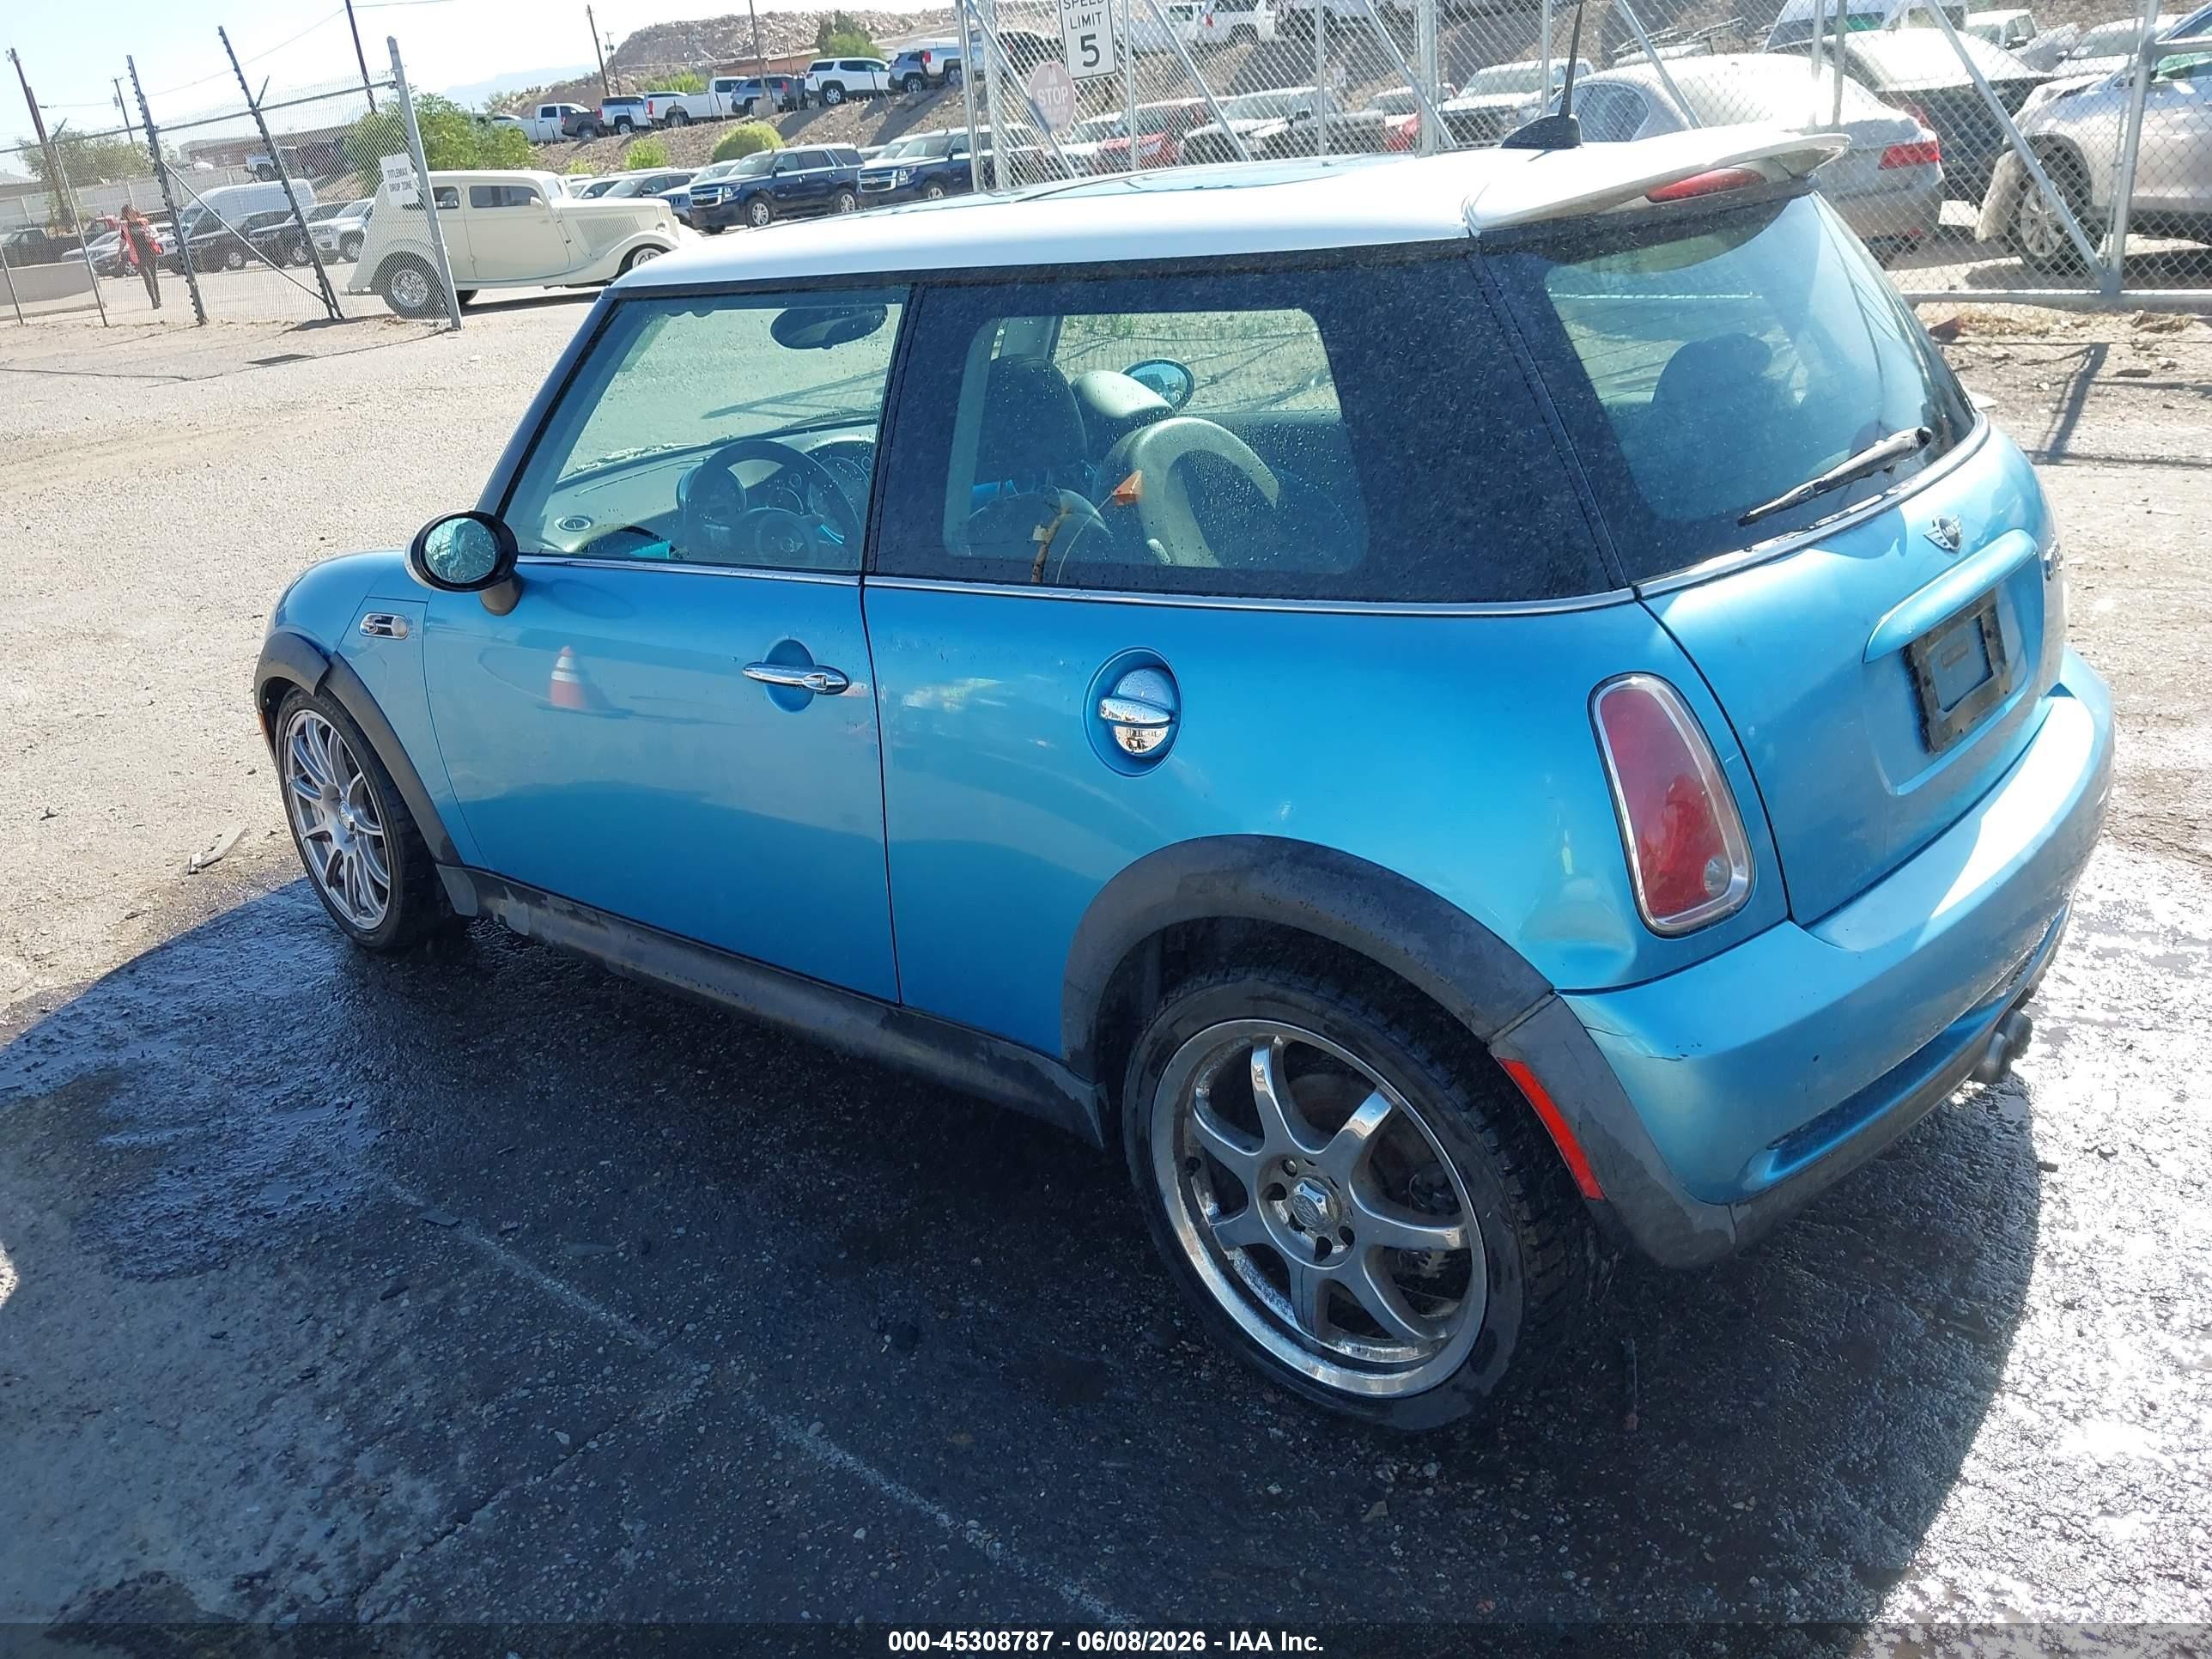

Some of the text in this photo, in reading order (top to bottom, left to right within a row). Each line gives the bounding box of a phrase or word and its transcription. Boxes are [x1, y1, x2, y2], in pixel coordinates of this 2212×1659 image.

[1063, 0, 1104, 10] SPE
[1069, 11, 1103, 29] LIMIT
[1080, 33, 1101, 68] 5
[1036, 85, 1068, 106] STOP
[386, 167, 408, 179] TITLEMAX
[388, 180, 413, 192] DROP ZONE
